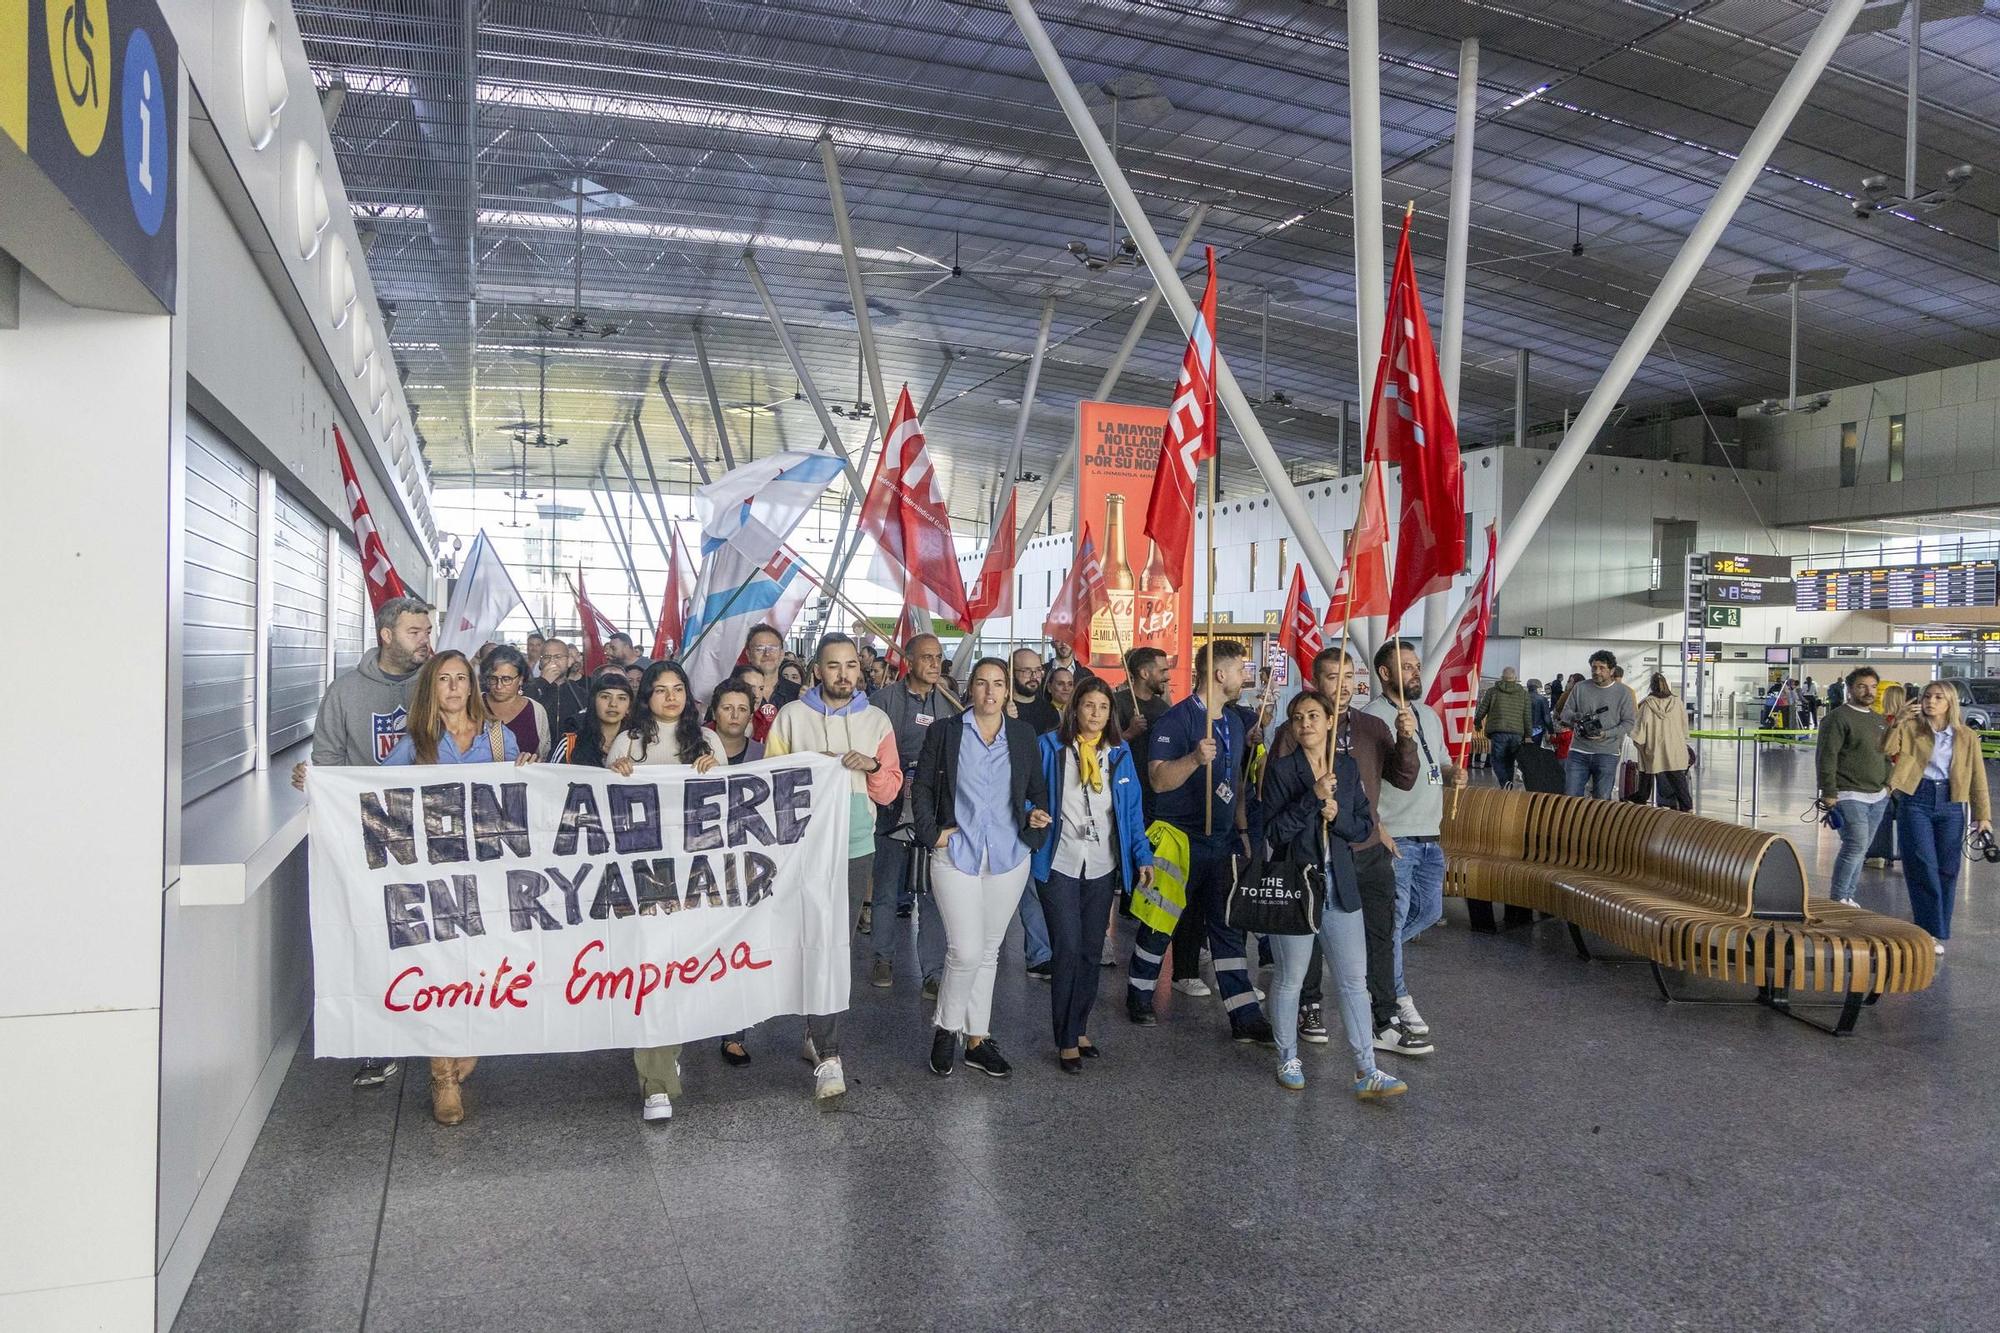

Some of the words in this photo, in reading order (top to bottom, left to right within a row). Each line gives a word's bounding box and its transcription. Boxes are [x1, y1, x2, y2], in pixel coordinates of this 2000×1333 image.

[1097, 421, 1114, 433] LA
[1104, 433, 1122, 445] NO
[1125, 435, 1161, 449] LLAM
[1097, 444, 1106, 456] A
[1109, 445, 1134, 458] LAS
[1136, 447, 1161, 460] COS
[1084, 454, 1112, 468] POR
[1115, 457, 1132, 469] SU
[1138, 610, 1174, 635] RED
[1218, 613, 1228, 624] 23
[1266, 612, 1277, 624] 22
[360, 782, 532, 869] NON
[552, 782, 664, 857] AO
[683, 767, 813, 853] ERE
[1261, 877, 1284, 888] THE
[384, 874, 487, 949] EN
[506, 851, 778, 932] RYANAIR
[1240, 886, 1273, 898] TOTE
[1275, 888, 1302, 899] BAG
[385, 956, 534, 1013] Comité
[566, 940, 773, 1016] Empresa
